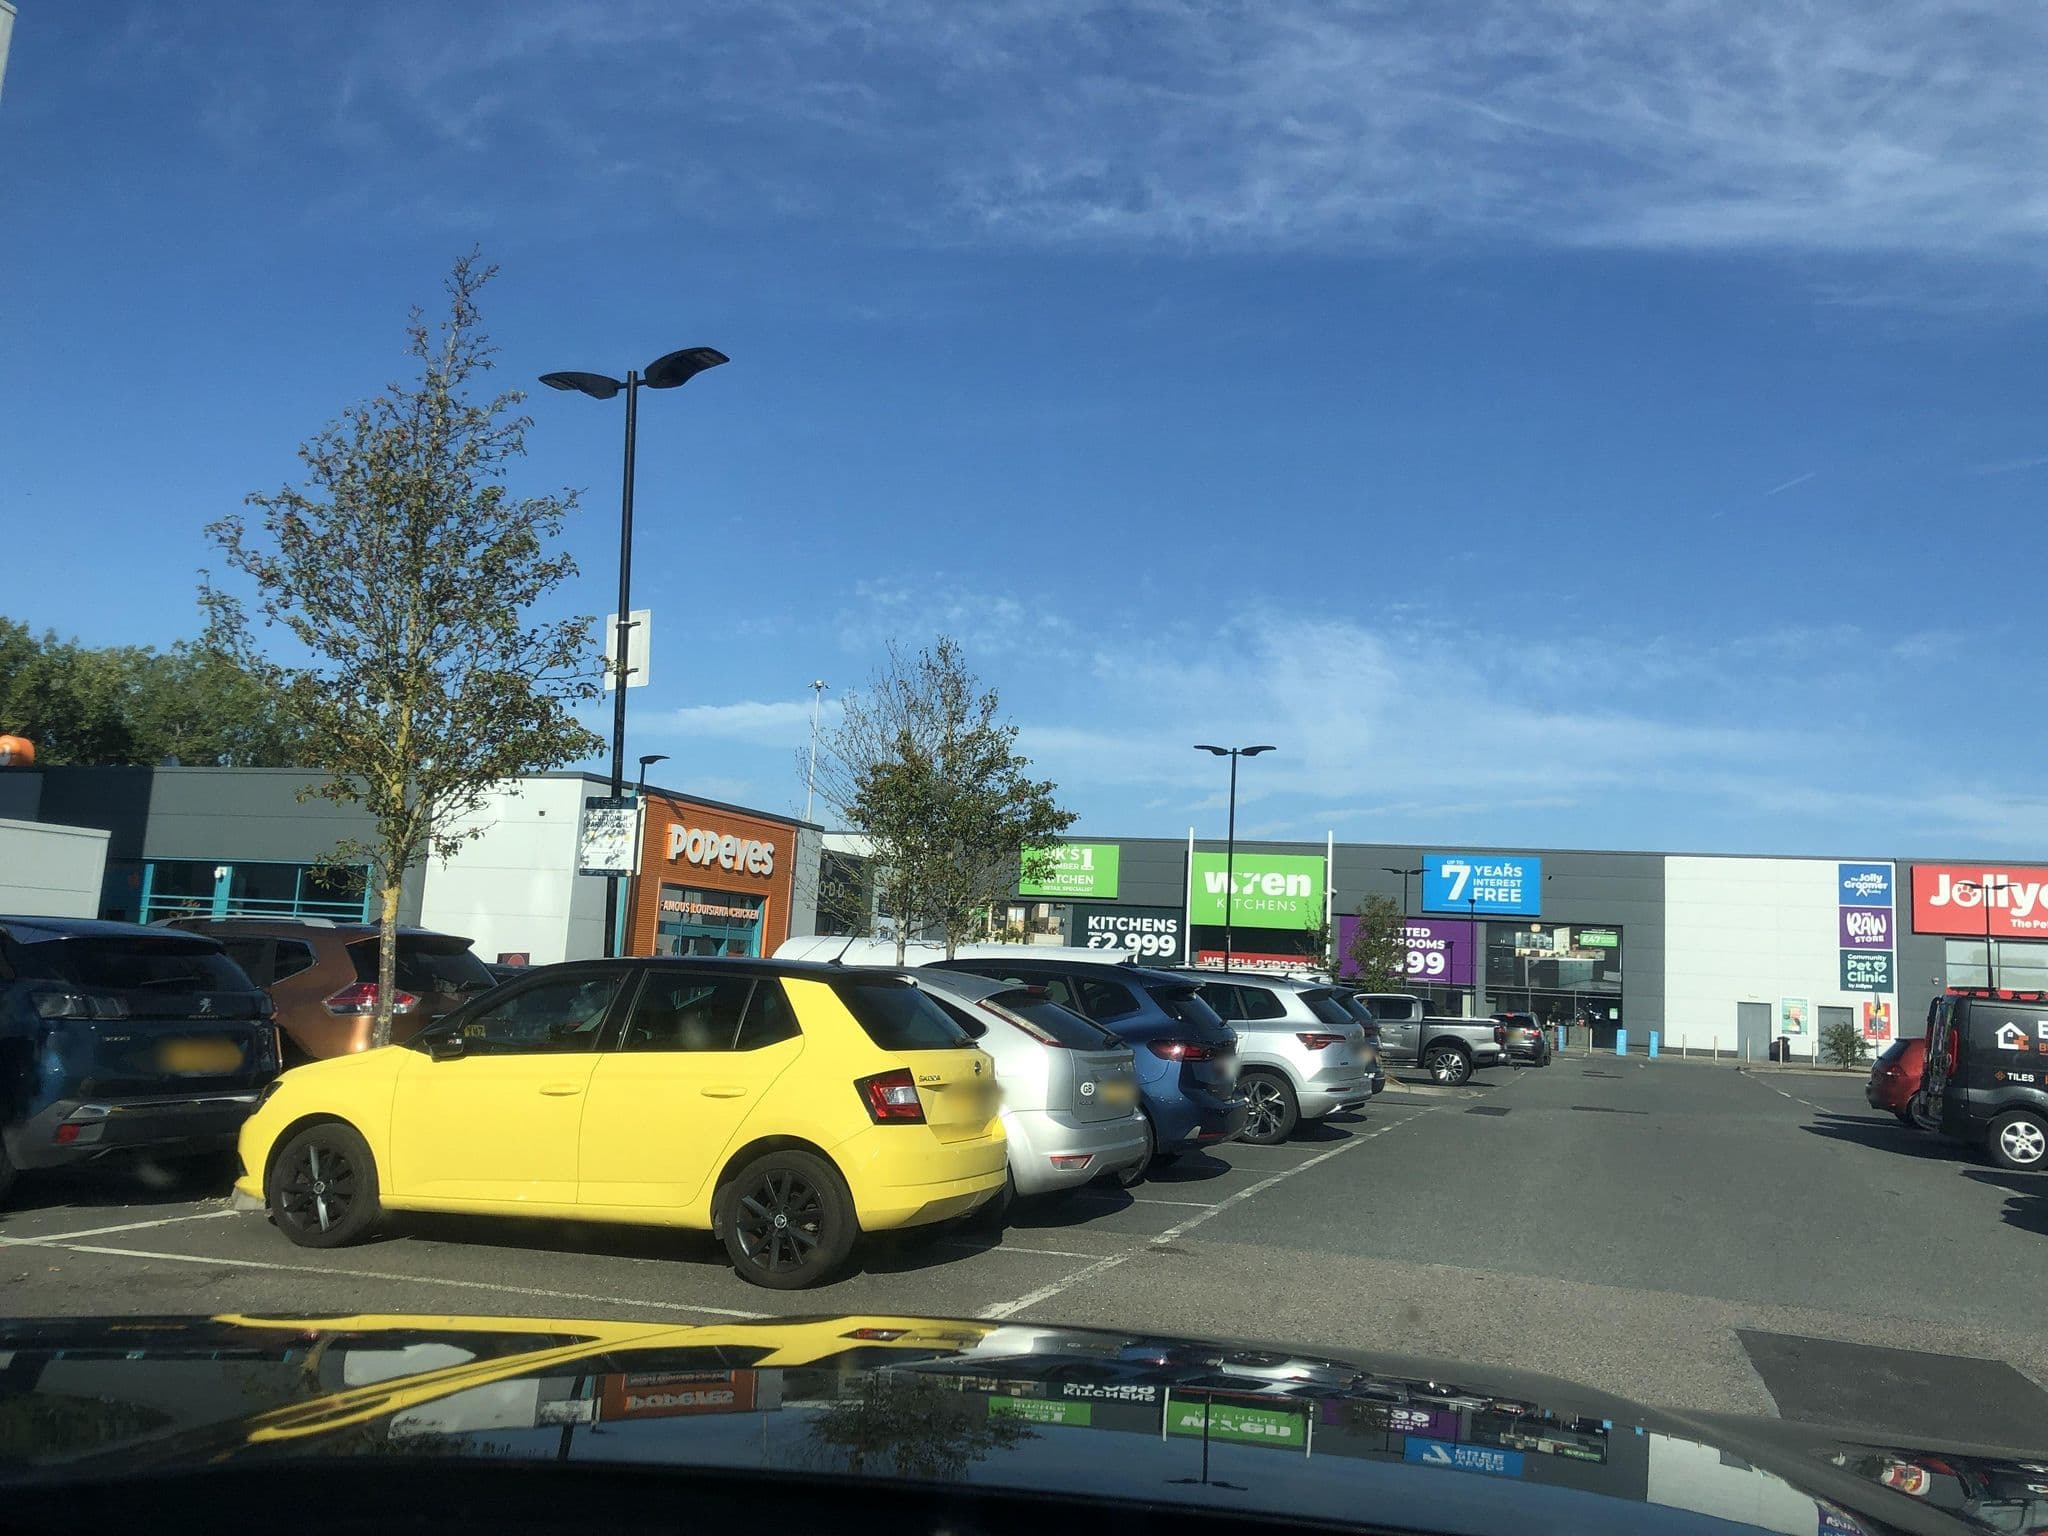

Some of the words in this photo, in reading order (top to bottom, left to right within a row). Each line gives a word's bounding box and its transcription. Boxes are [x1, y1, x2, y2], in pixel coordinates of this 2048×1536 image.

[1045, 862, 1080, 870] UMBER
[1474, 864, 1522, 877] YEARS
[1441, 864, 1471, 901] 7
[1859, 873, 1883, 883] Jolly
[1473, 879, 1522, 888] INTEREST
[1843, 880, 1889, 890] Groomer
[1474, 888, 1522, 902] FREE
[1216, 898, 1297, 912] KTCHENS
[1087, 915, 1178, 933] KITCHENS
[1846, 912, 1887, 936] RAW
[2010, 919, 2033, 929] The
[2033, 919, 2048, 929] Pe
[1854, 935, 1885, 944] STORE
[1847, 953, 1887, 962] Community
[1847, 960, 1872, 971] Pet
[1847, 971, 1888, 984] Clinic
[2007, 1072, 2035, 1082] TILES
